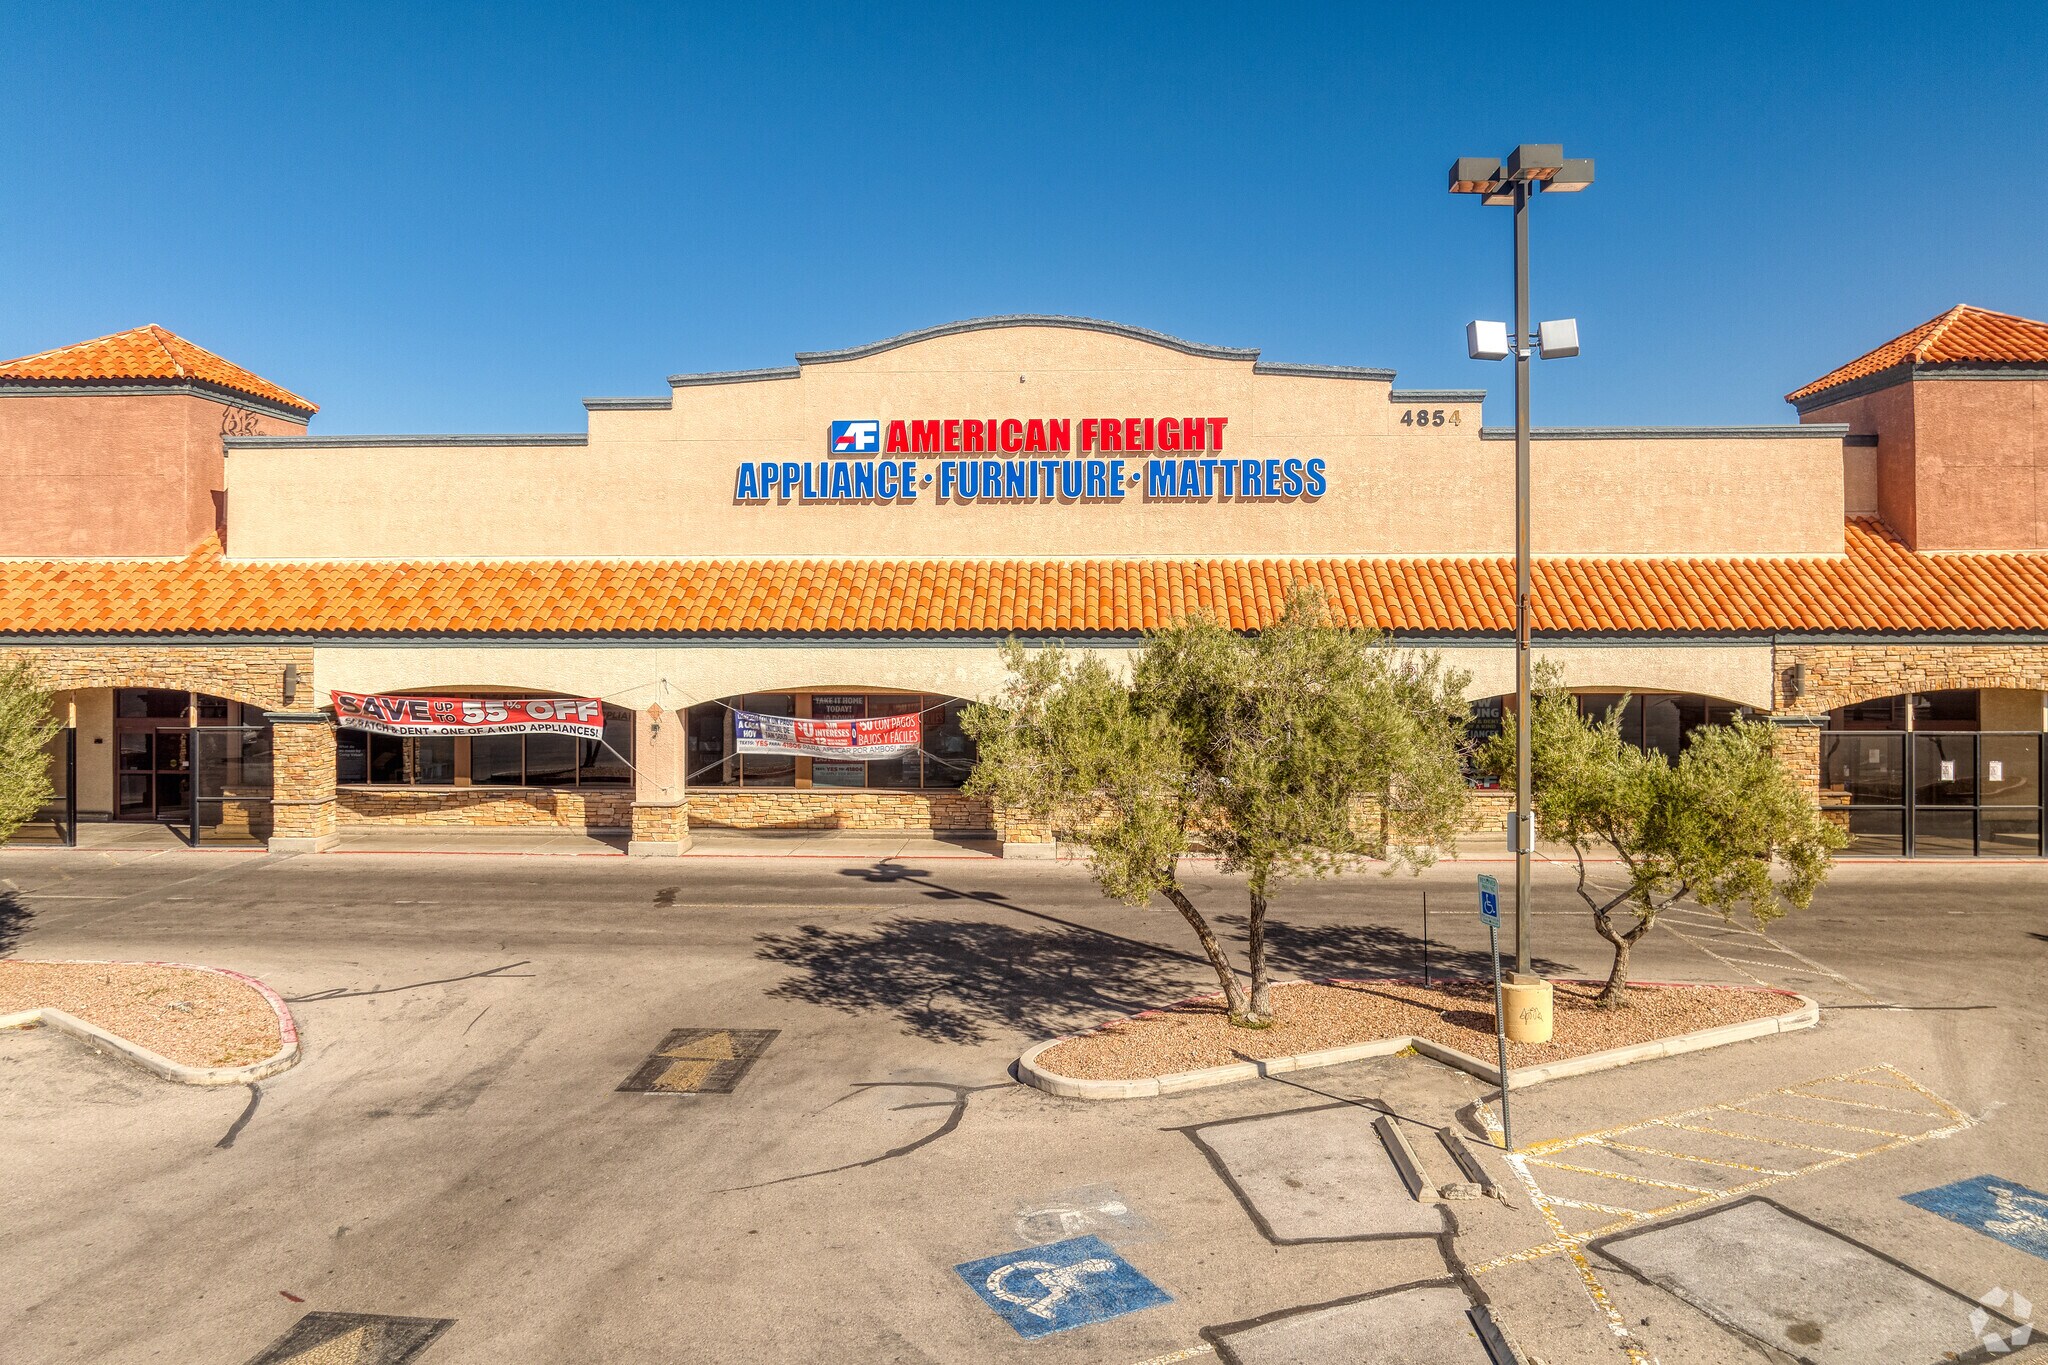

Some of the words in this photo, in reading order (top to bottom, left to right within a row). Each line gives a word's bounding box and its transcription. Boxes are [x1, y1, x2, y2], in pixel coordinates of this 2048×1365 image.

[1400, 410, 1461, 427] 4854
[886, 419, 1071, 454] AMERICAN
[1081, 417, 1229, 453] FREIGHT
[736, 460, 918, 500] APPLIANCE
[940, 459, 1126, 500] FURNITURE
[1148, 458, 1328, 498] MATTRESS
[842, 696, 864, 704] HOME
[338, 695, 433, 722] SAVE
[434, 701, 454, 712] UP
[462, 699, 522, 724] 55%
[525, 700, 600, 722] OFF
[826, 705, 852, 713] TODAY!
[436, 714, 456, 724] TO
[874, 718, 890, 731] CON
[891, 715, 916, 728] PAGOS
[400, 727, 430, 735] DENT
[487, 726, 496, 734] A
[498, 724, 527, 733] KIND
[530, 723, 599, 738] APPLIANCES!
[743, 729, 757, 738] HOY
[814, 728, 850, 738] INTERESES
[815, 737, 827, 745] 12
[858, 733, 882, 746] BAJOS
[883, 732, 888, 741] Y
[853, 745, 868, 754] POR
